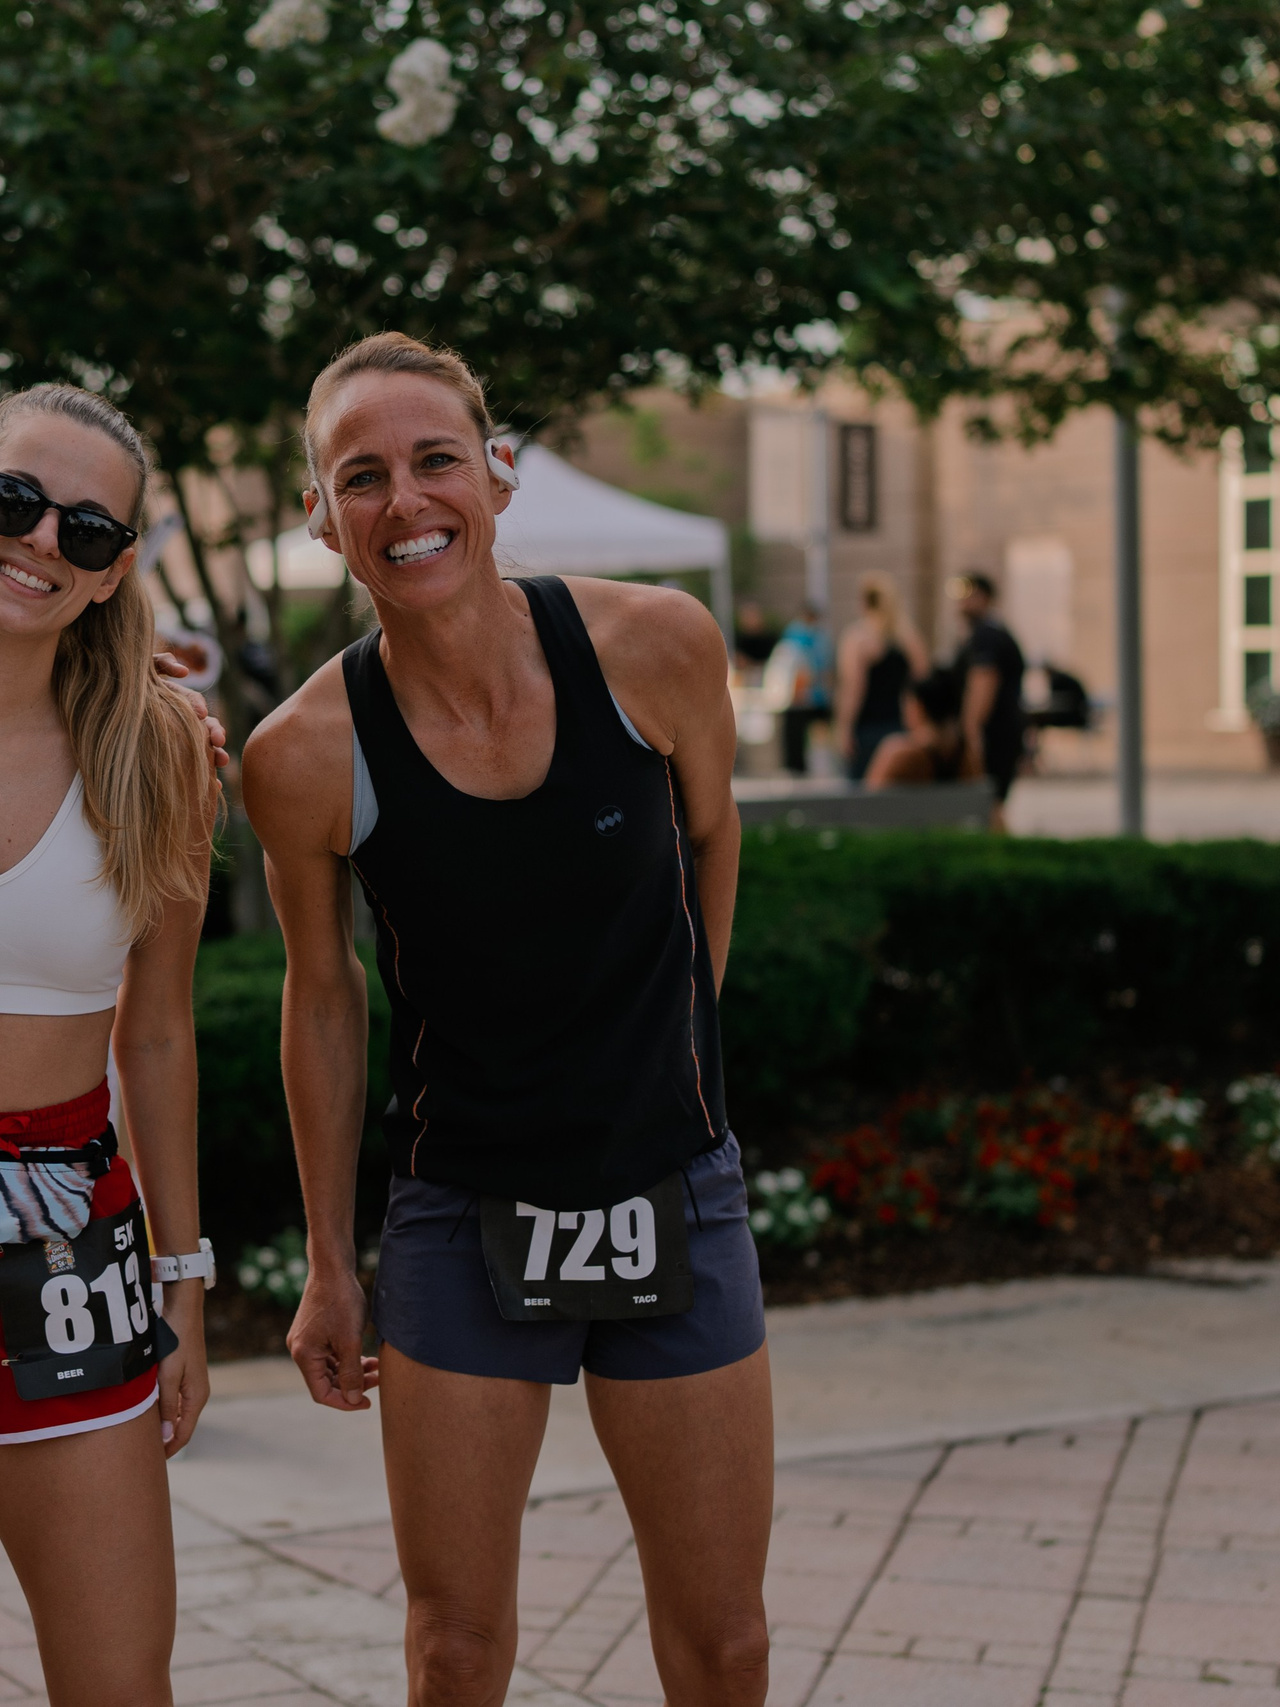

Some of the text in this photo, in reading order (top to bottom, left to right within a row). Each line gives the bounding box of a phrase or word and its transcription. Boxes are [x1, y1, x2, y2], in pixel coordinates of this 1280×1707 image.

[114, 1218, 135, 1251] 5K
[516, 1196, 657, 1281] 729
[41, 1251, 149, 1354] 813
[524, 1298, 551, 1306] BEER
[633, 1294, 657, 1304] TACO
[57, 1368, 84, 1380] BEER
